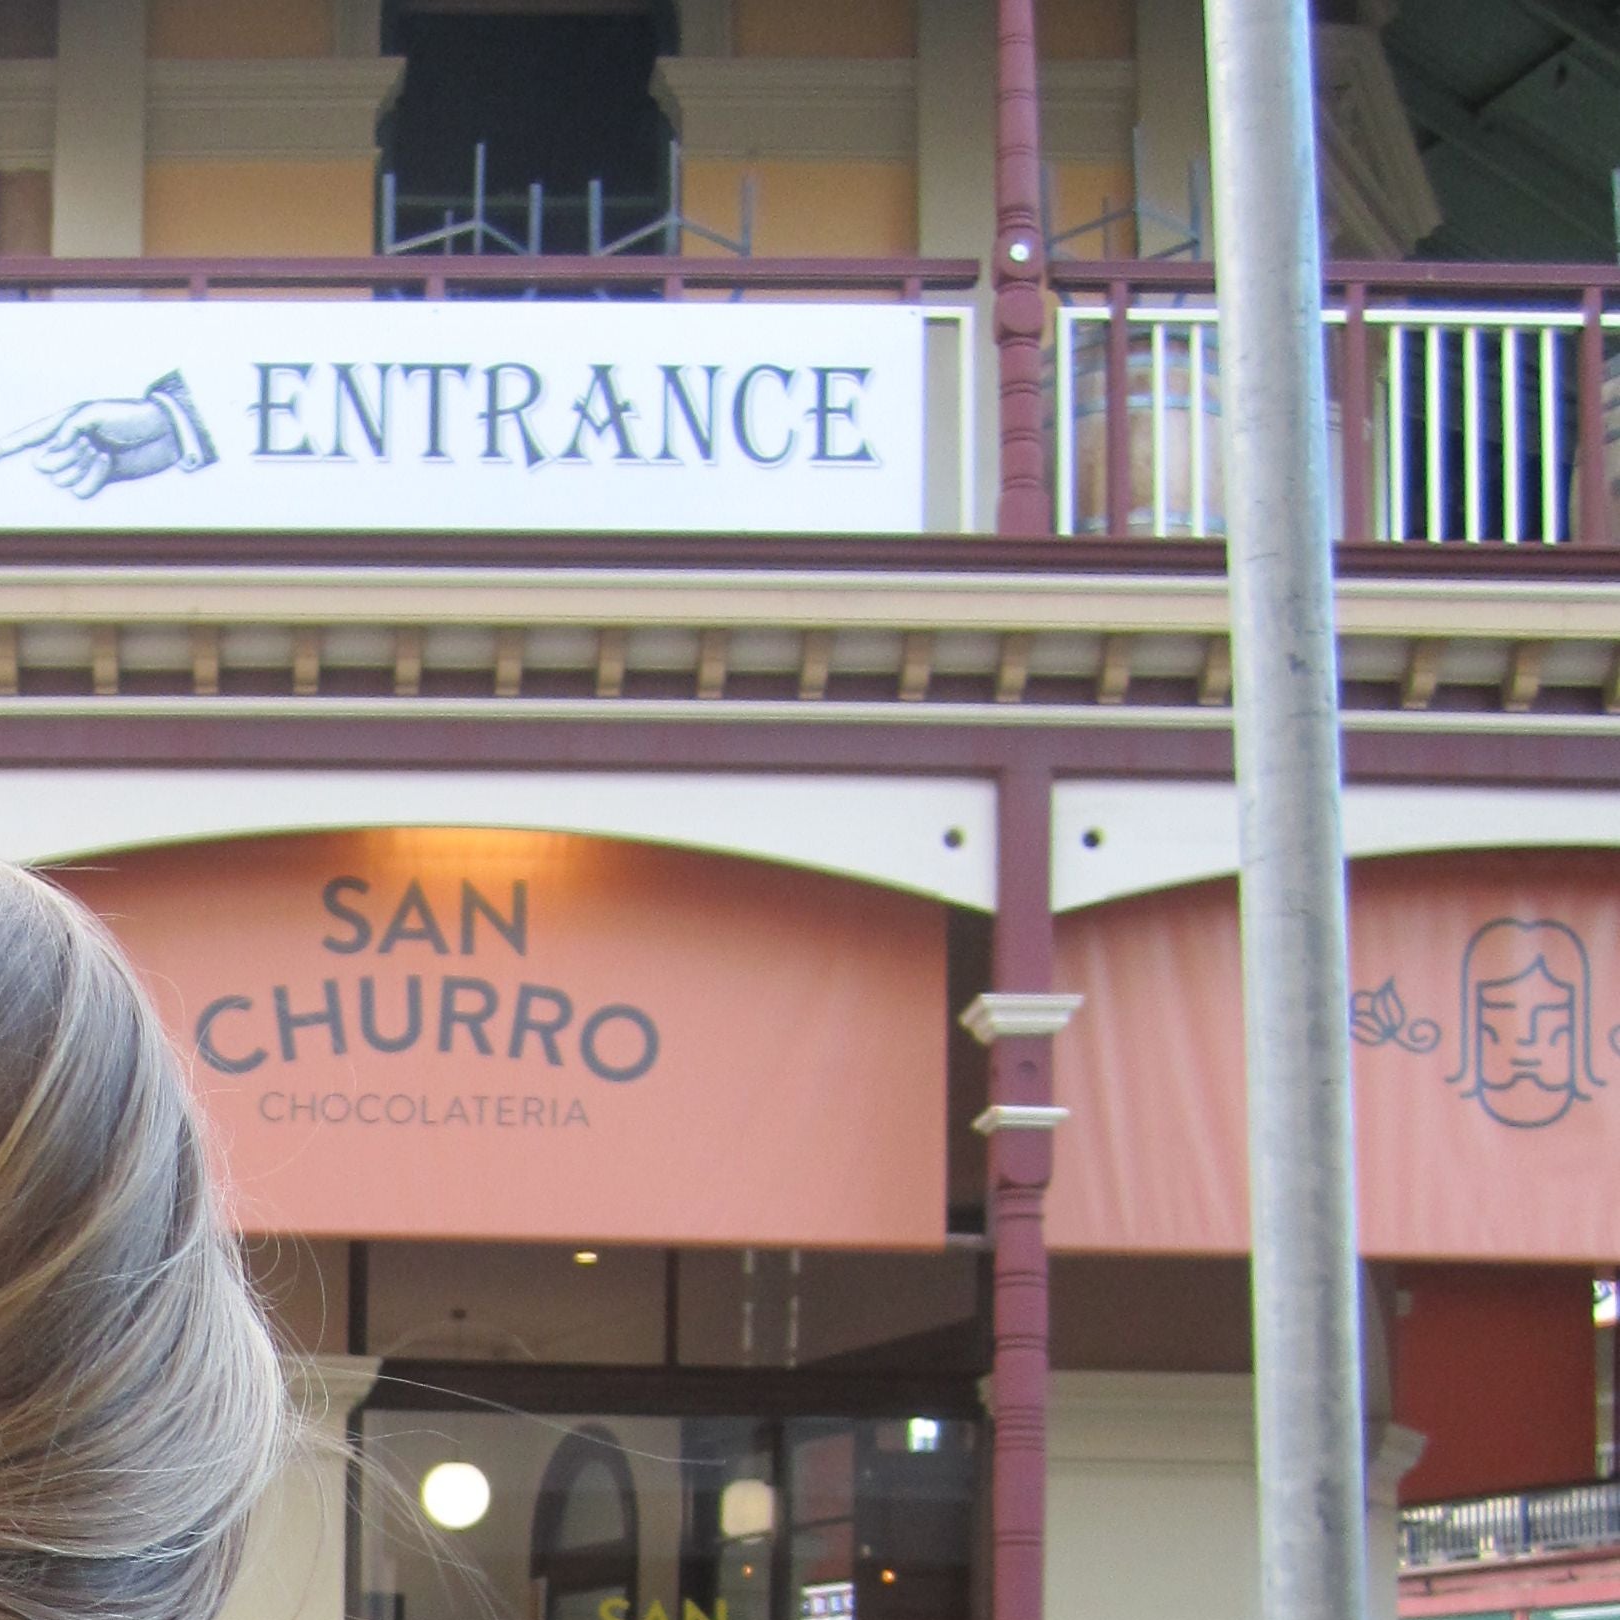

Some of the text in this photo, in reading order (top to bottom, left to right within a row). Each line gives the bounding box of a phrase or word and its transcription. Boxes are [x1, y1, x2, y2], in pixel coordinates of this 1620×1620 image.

[248, 361, 882, 469] ENTRANCE
[322, 875, 528, 957] SAN
[195, 974, 660, 1083] CHURRO
[259, 1091, 590, 1128] CHOCOLATERIA
